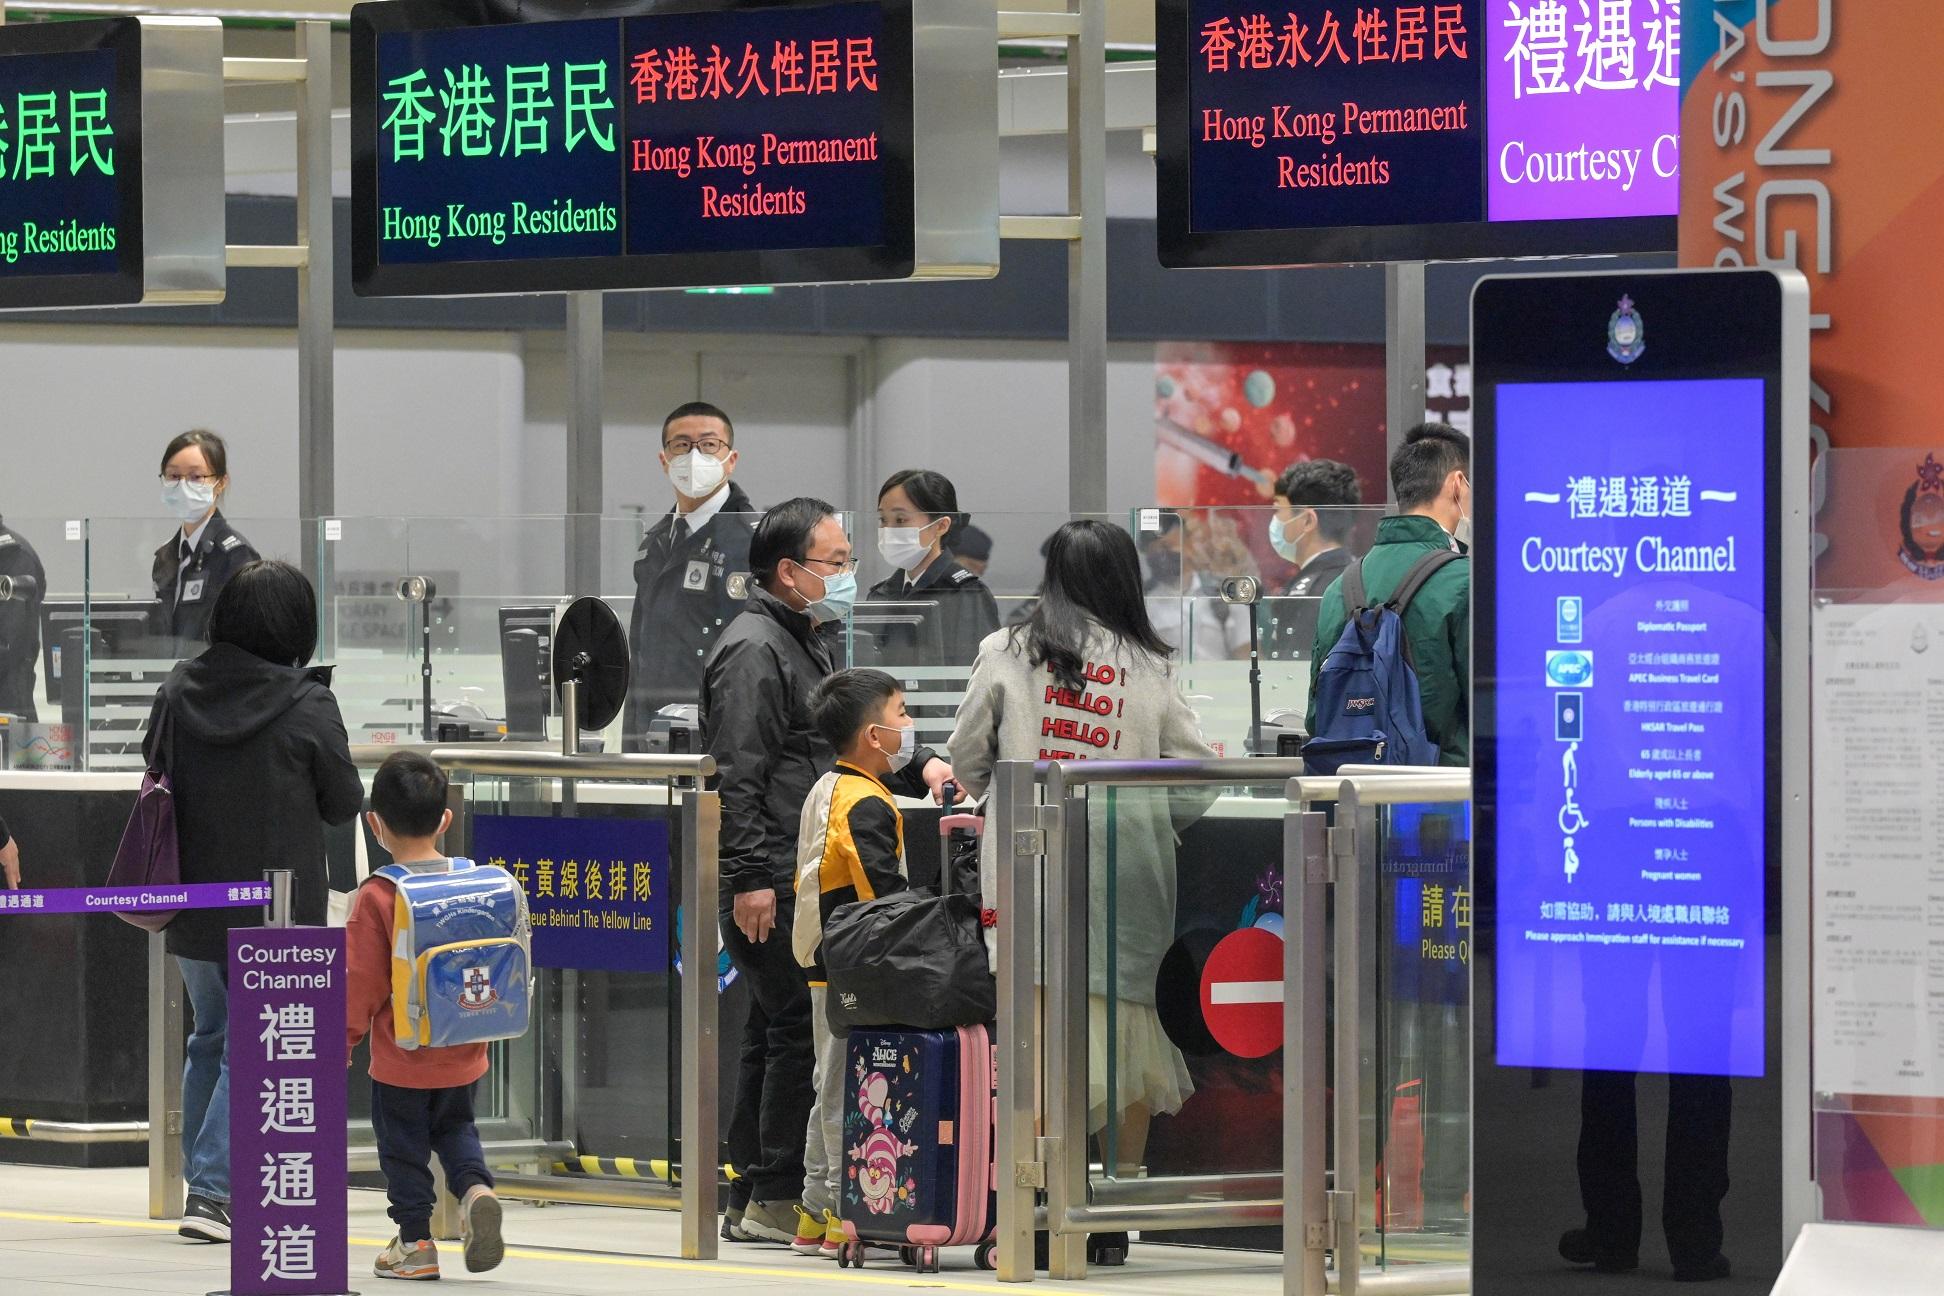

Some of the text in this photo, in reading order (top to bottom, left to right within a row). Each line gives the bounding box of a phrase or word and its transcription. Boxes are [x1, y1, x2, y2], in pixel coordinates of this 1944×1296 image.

[1200, 4, 1468, 73] 香港永久性居民
[630, 37, 878, 104] 香港永久性居民
[382, 59, 616, 163] 香港居民
[1202, 100, 1467, 148] Hong Kong Permanent
[0, 88, 115, 181] 居民
[632, 131, 877, 178] Hong Kong Permanent
[1277, 153, 1390, 189] Residents
[1500, 135, 1679, 191] Courtesy C
[702, 185, 806, 218] Residents
[24, 219, 116, 254] Residents
[383, 199, 617, 247] Hong Kong Residents
[1566, 475, 1692, 519] 禮遇通道
[1522, 536, 1736, 578] Courtesy Channel
[1637, 621, 1707, 633] Diplomatic Passport
[1629, 673, 1719, 683] APEC Business Travel Card
[1666, 722, 1687, 732] Travel
[1688, 722, 1705, 732] Pass
[1654, 770, 1671, 781] aged
[1683, 771, 1691, 779] or
[1692, 770, 1714, 780] above
[86, 891, 188, 907] Courtesy Channel
[550, 908, 580, 928] Behind
[583, 910, 599, 929] The
[602, 911, 630, 931] Yellow
[633, 912, 652, 931] Line
[237, 944, 336, 965] Courtesy
[1422, 939, 1470, 965] Please Q
[243, 970, 331, 990] Channel
[259, 1003, 317, 1281] 禮遇通道
